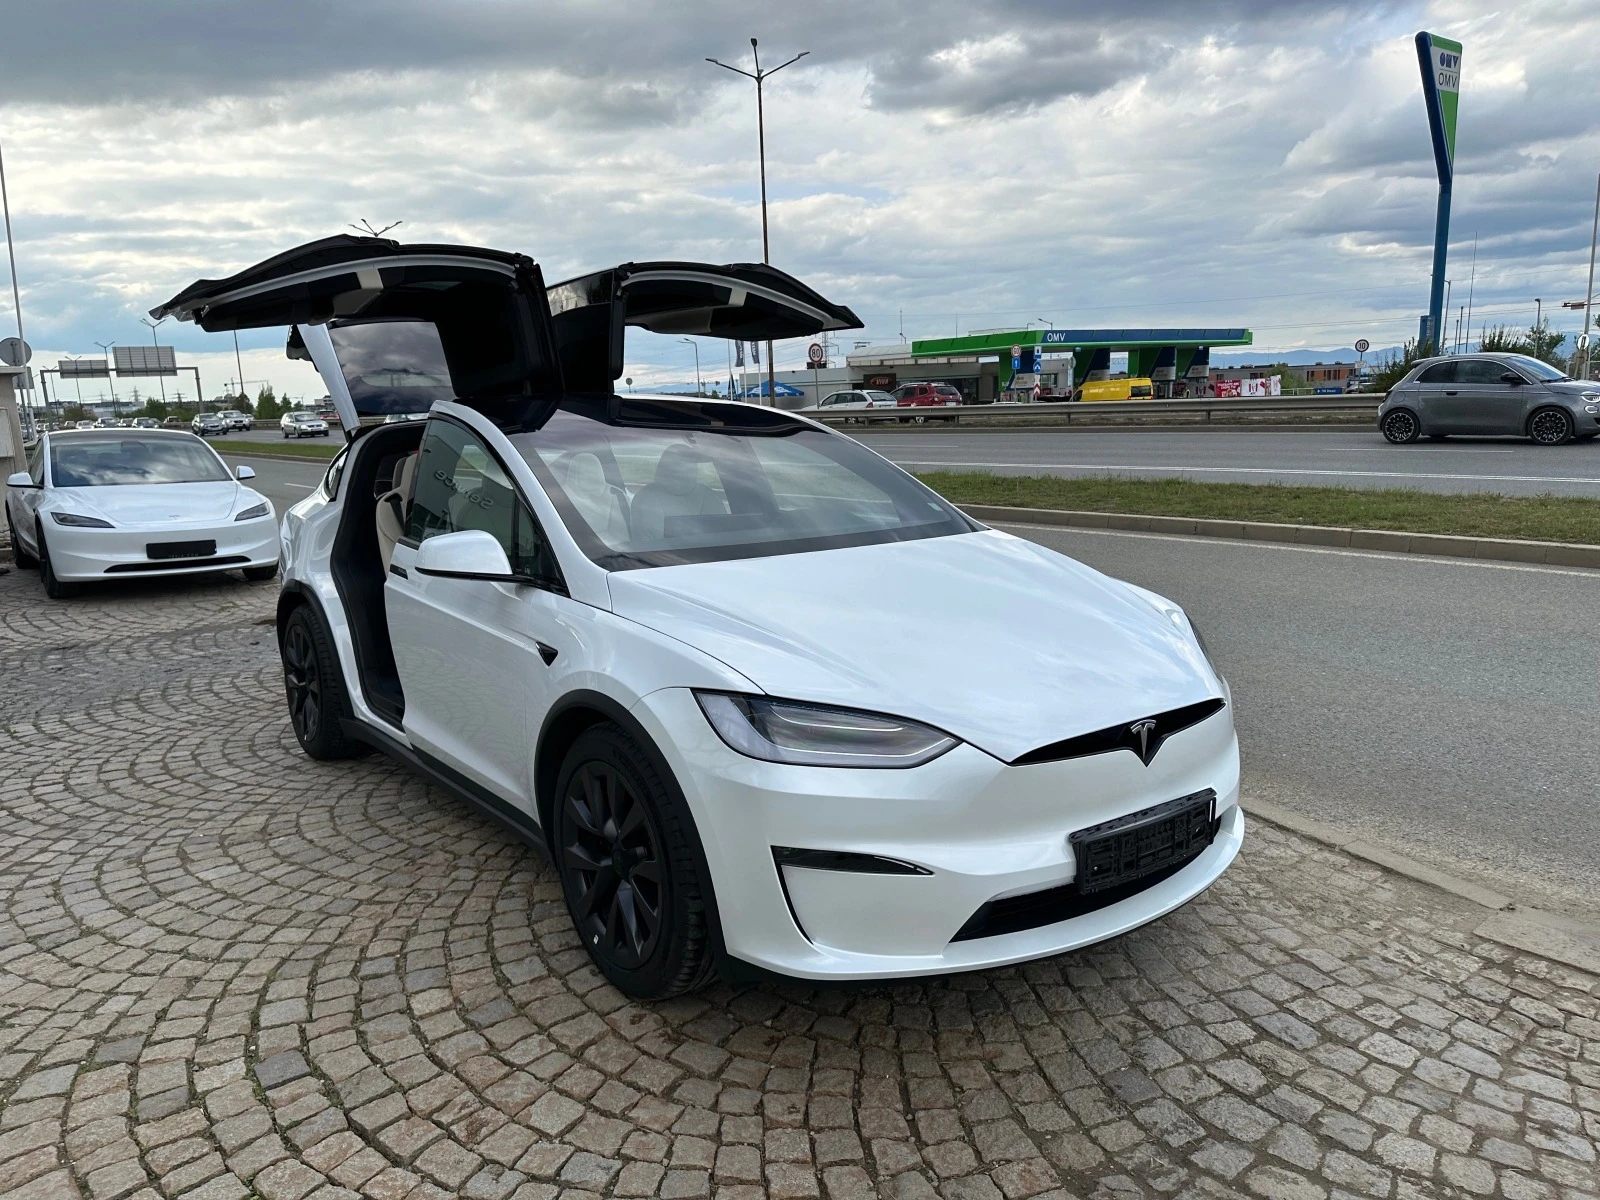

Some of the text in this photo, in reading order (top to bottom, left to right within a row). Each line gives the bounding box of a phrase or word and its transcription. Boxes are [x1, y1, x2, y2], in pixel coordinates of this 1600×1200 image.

[1440, 52, 1459, 68] OMV
[1439, 72, 1457, 88] OMV
[1046, 333, 1066, 342] OMV
[1359, 342, 1366, 350] 10
[812, 348, 821, 358] 80
